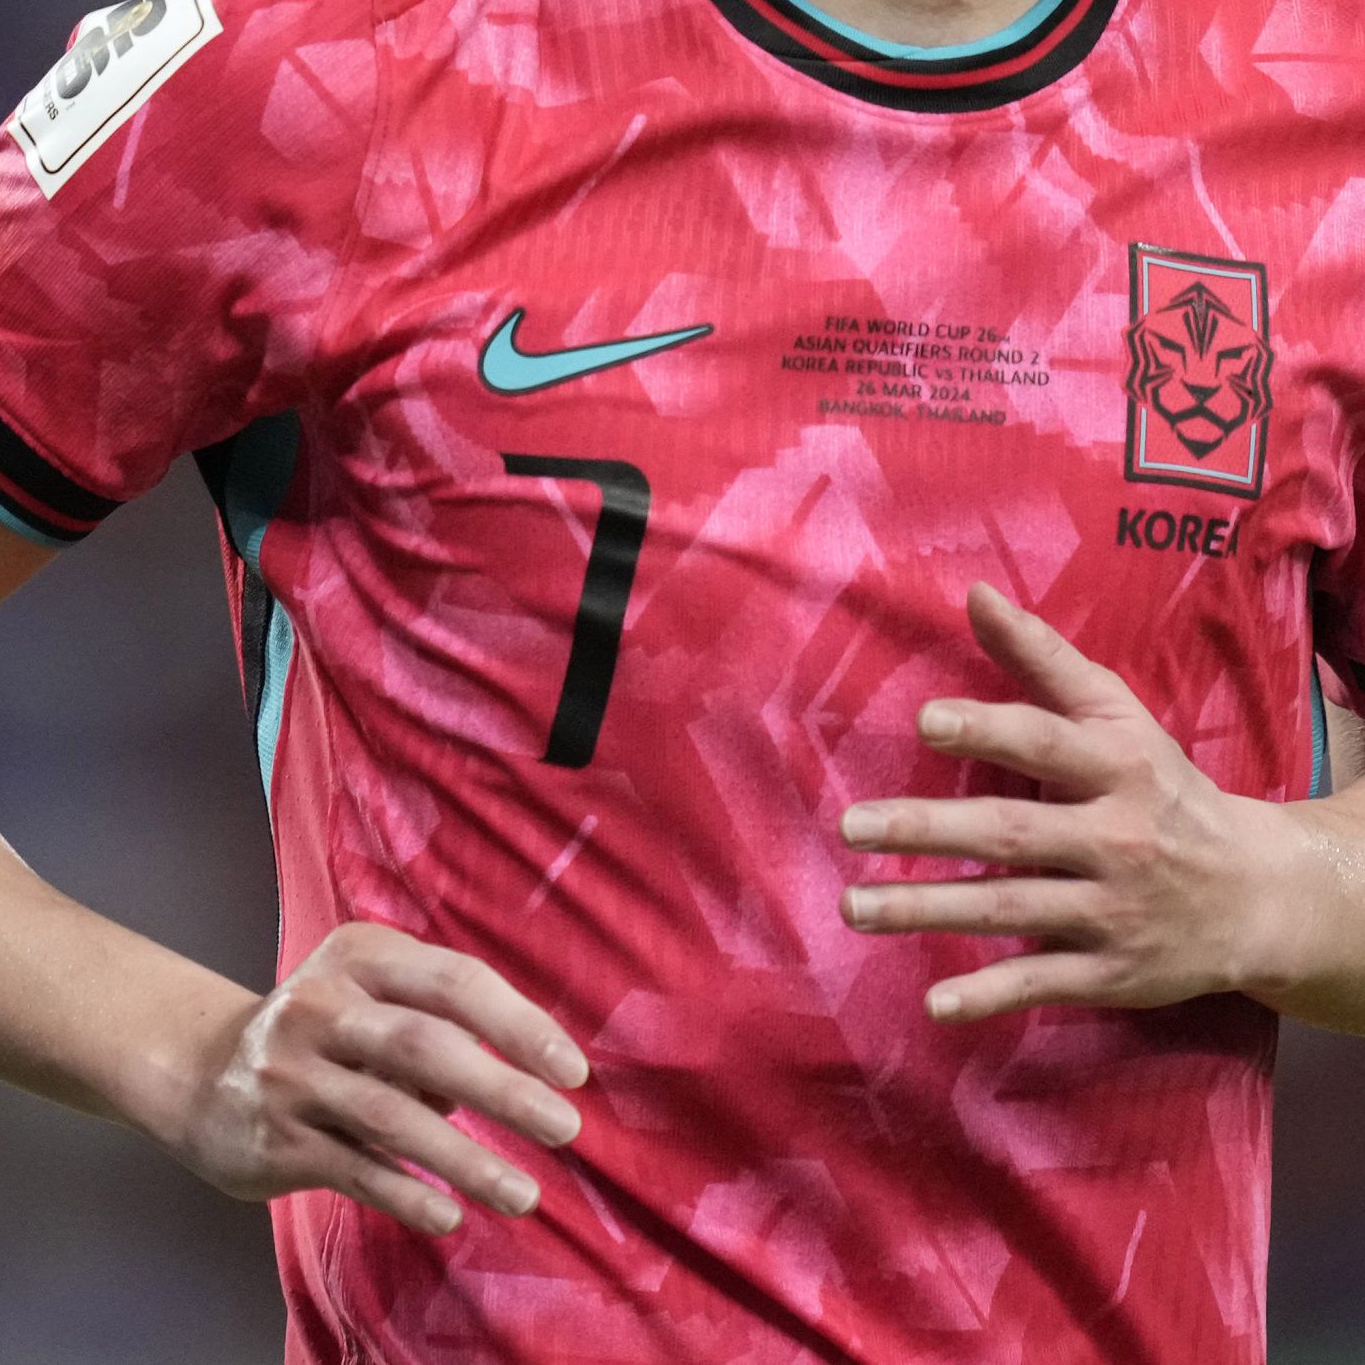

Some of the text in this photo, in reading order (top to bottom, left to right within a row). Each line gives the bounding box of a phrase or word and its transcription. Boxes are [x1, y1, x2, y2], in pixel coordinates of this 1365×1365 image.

[825, 316, 860, 332] FIFA
[866, 320, 930, 337] WORLD
[936, 324, 971, 340] CUP
[793, 335, 1040, 365] ASIAN QUALIFIERS ROUND 2
[781, 356, 839, 373] KOREA
[845, 360, 927, 379] REPUBLIC
[960, 367, 1051, 386] THAILAND
[856, 380, 971, 402] 26 MAR 2024
[916, 405, 1007, 425] THAILAND
[499, 451, 651, 771] 7
